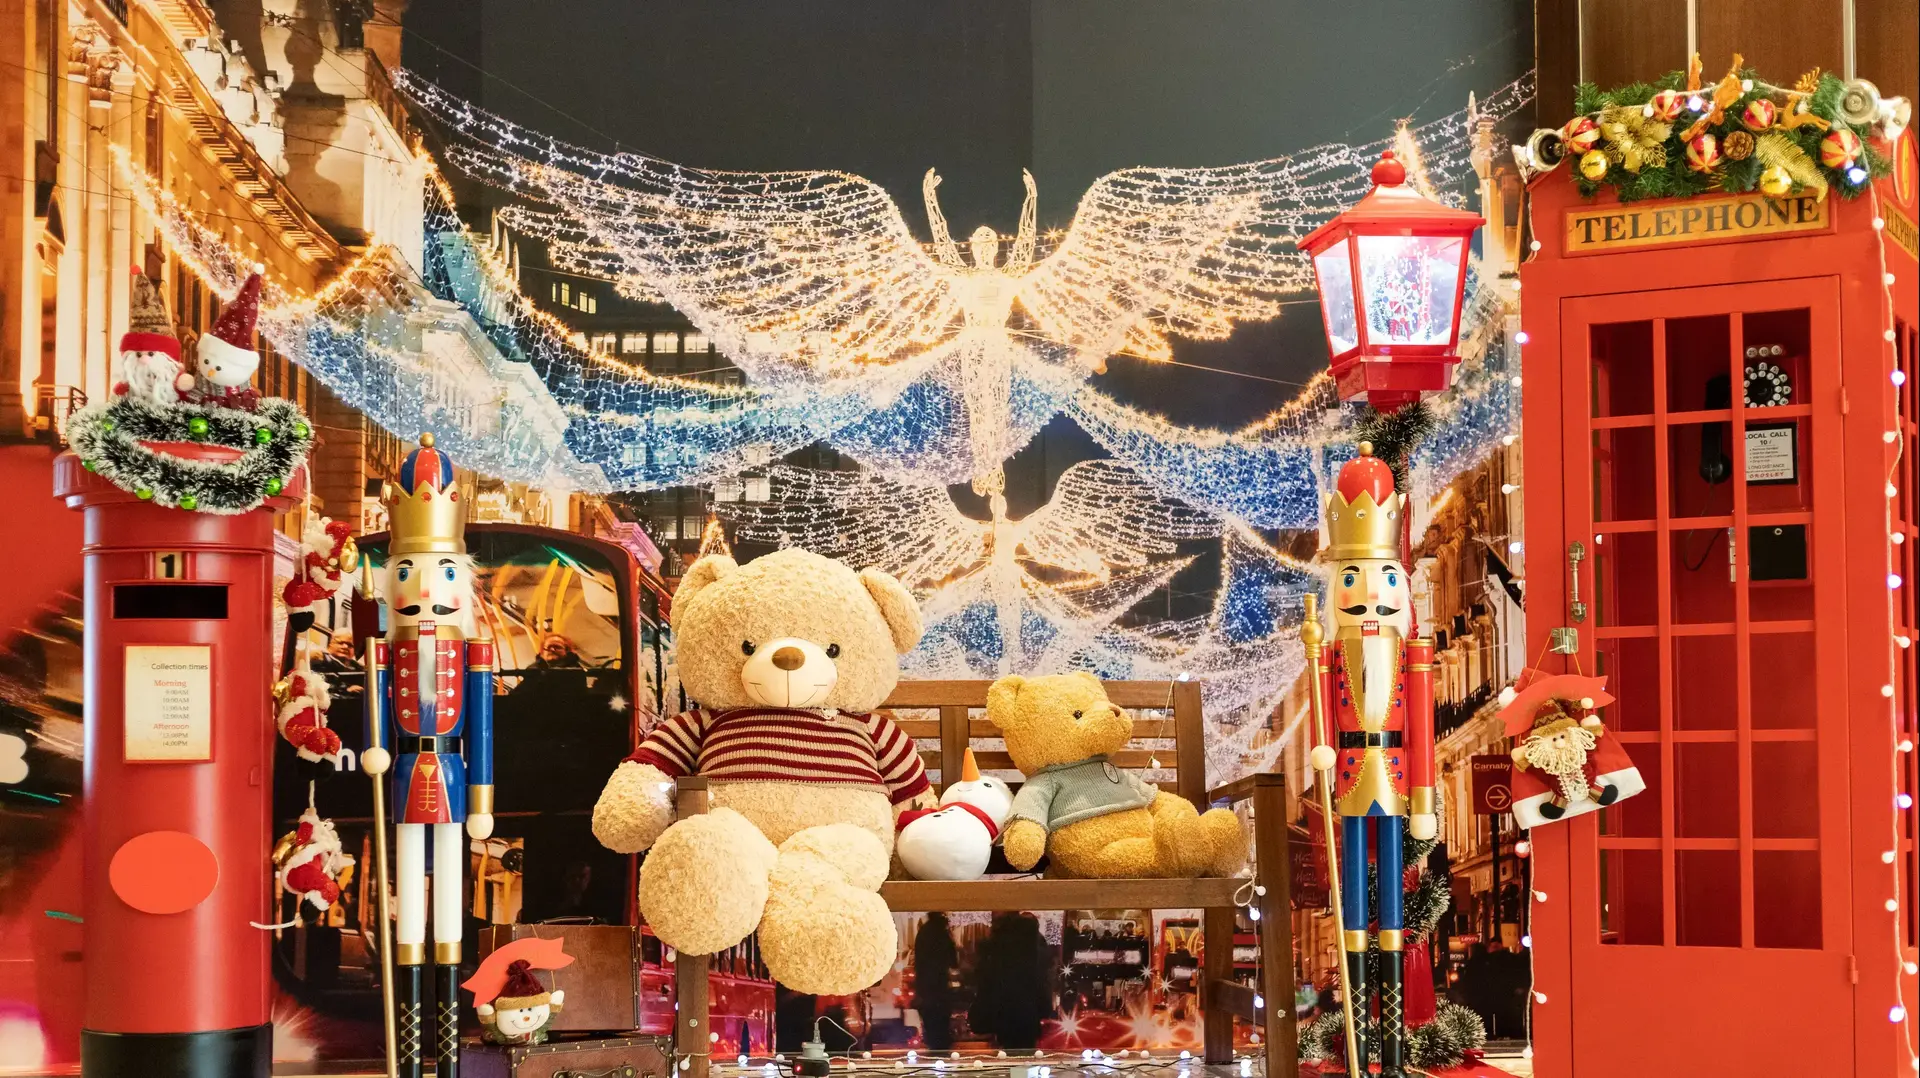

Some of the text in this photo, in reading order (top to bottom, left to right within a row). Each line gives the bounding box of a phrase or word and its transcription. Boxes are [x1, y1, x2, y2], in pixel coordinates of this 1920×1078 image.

[1576, 195, 1820, 244] TELEPHONE
[161, 554, 175, 578] 1
[154, 680, 187, 688] Morning
[1473, 762, 1511, 772] Carnaby
